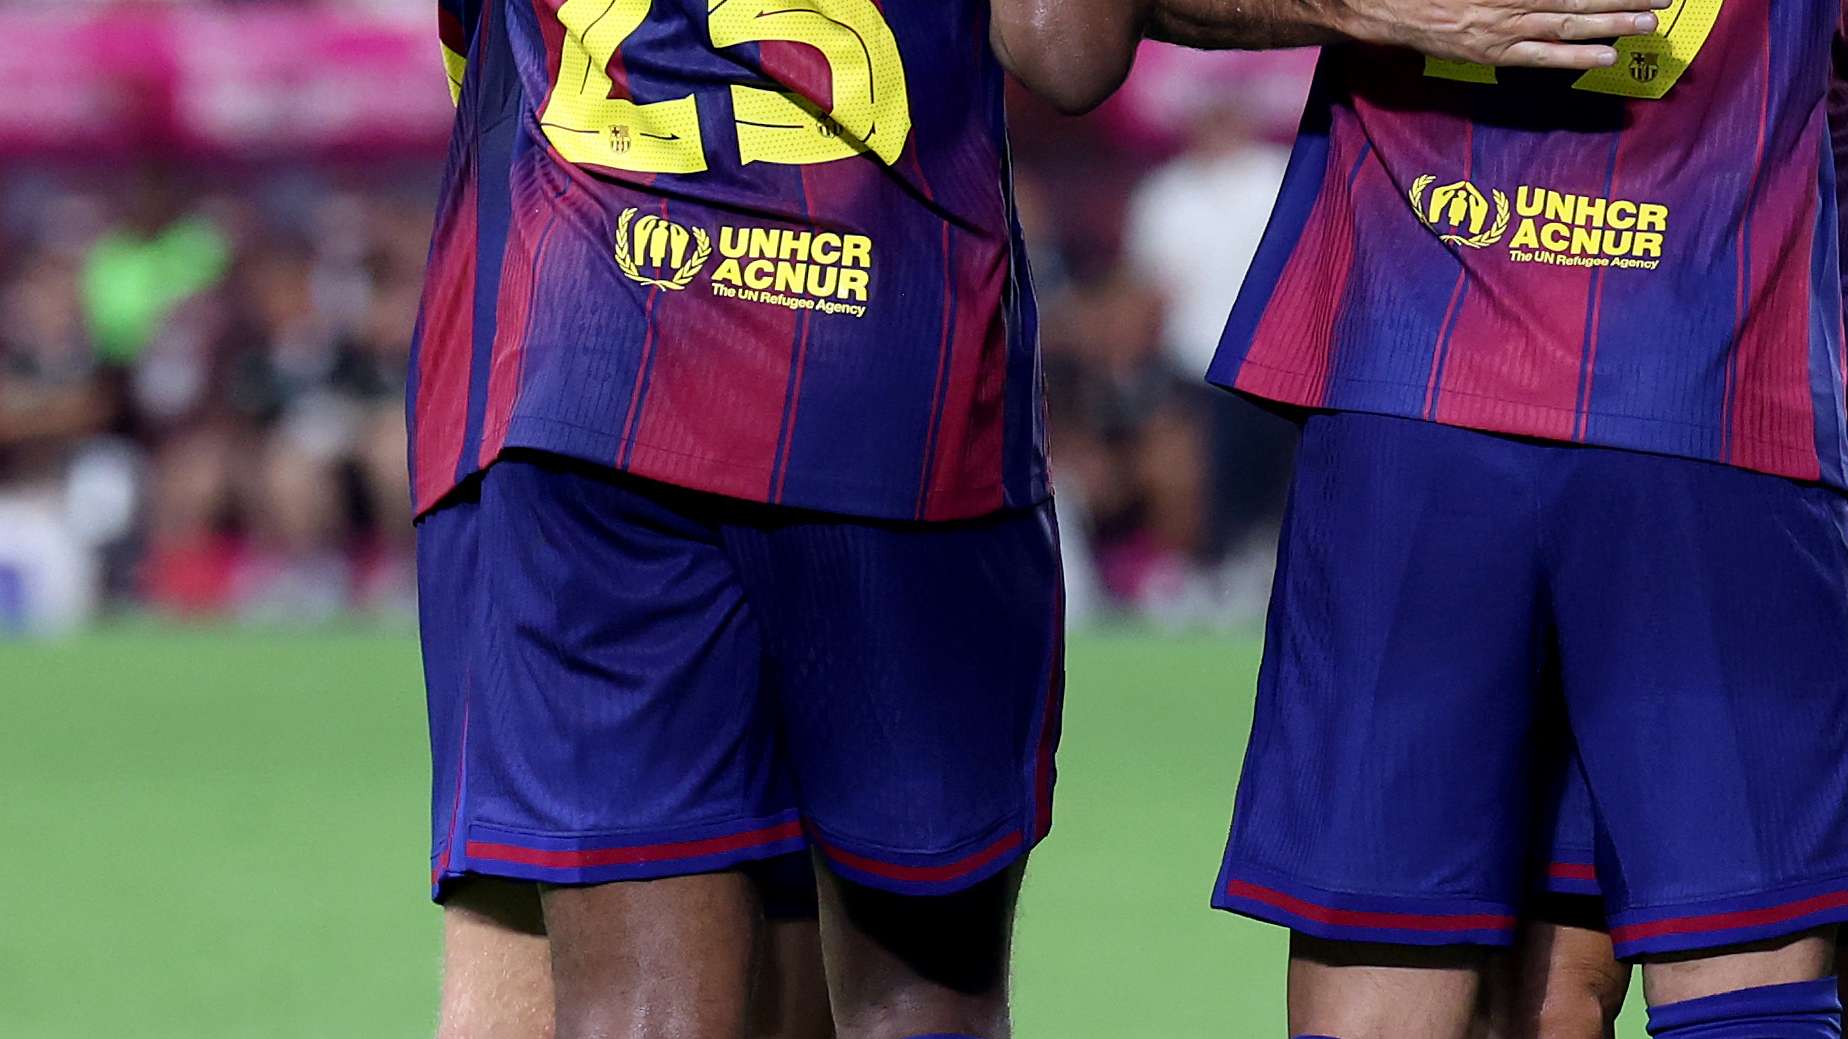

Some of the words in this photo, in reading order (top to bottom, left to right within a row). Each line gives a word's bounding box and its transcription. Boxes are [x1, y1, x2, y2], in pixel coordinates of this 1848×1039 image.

[1516, 185, 1669, 231] UNHCR
[719, 226, 872, 268] UNHCR
[1508, 218, 1664, 258] ACNUR
[711, 258, 870, 302] ACNUR
[1509, 250, 1533, 262] The
[1533, 250, 1555, 265] UN
[1555, 254, 1609, 268] Refugee
[1610, 256, 1660, 270] Agency
[711, 282, 737, 298] The
[737, 288, 759, 302] UN
[759, 291, 815, 310] Refugee
[815, 298, 866, 318] Agency
